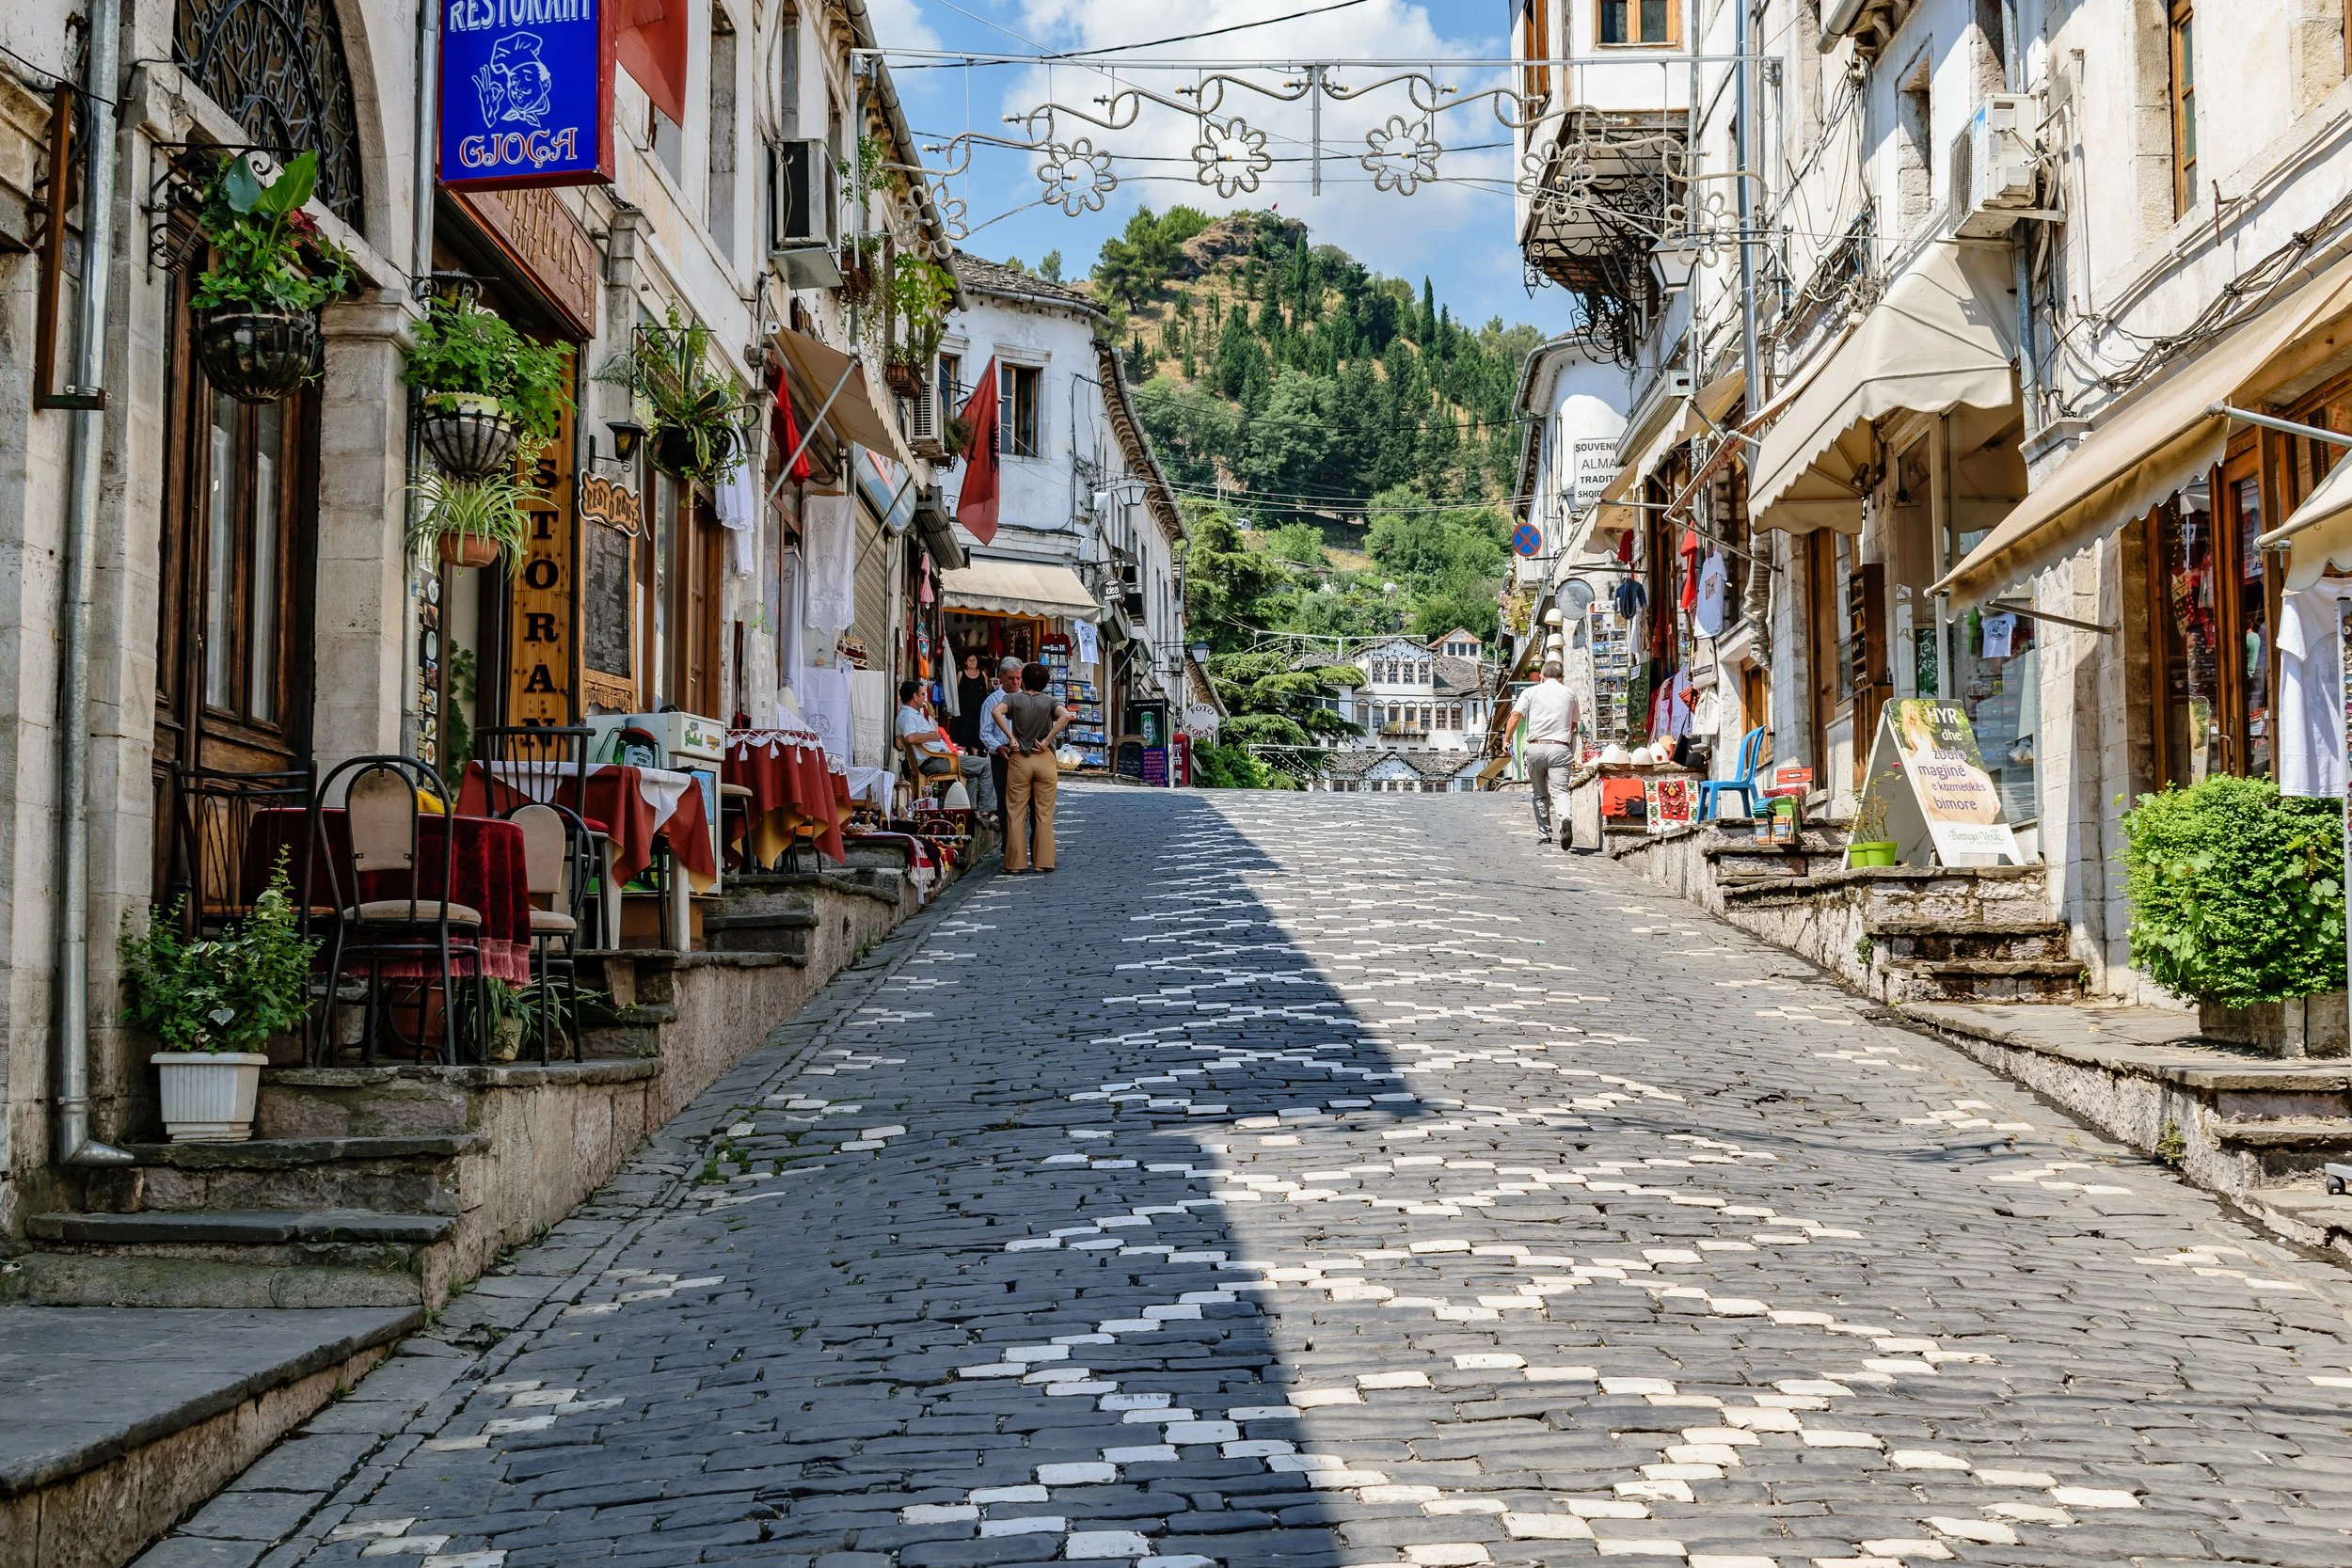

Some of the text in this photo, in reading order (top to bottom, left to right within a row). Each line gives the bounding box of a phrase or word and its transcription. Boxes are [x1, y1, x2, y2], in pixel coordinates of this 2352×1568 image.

[459, 127, 579, 168] GJOÇA
[1575, 442, 1616, 452] SOUVENI
[1581, 457, 1617, 470] ALMA
[1580, 474, 1617, 484] TRADIT
[1190, 705, 1215, 716] FOTO
[1926, 707, 1958, 724] HYR
[1186, 723, 1215, 736] KOPJE
[1941, 728, 1963, 741] dhe
[1931, 746, 1967, 761] zbulo
[1918, 765, 1966, 780] magjinë
[1939, 781, 1987, 792] kozmetikës
[1933, 796, 1978, 810] bimore
